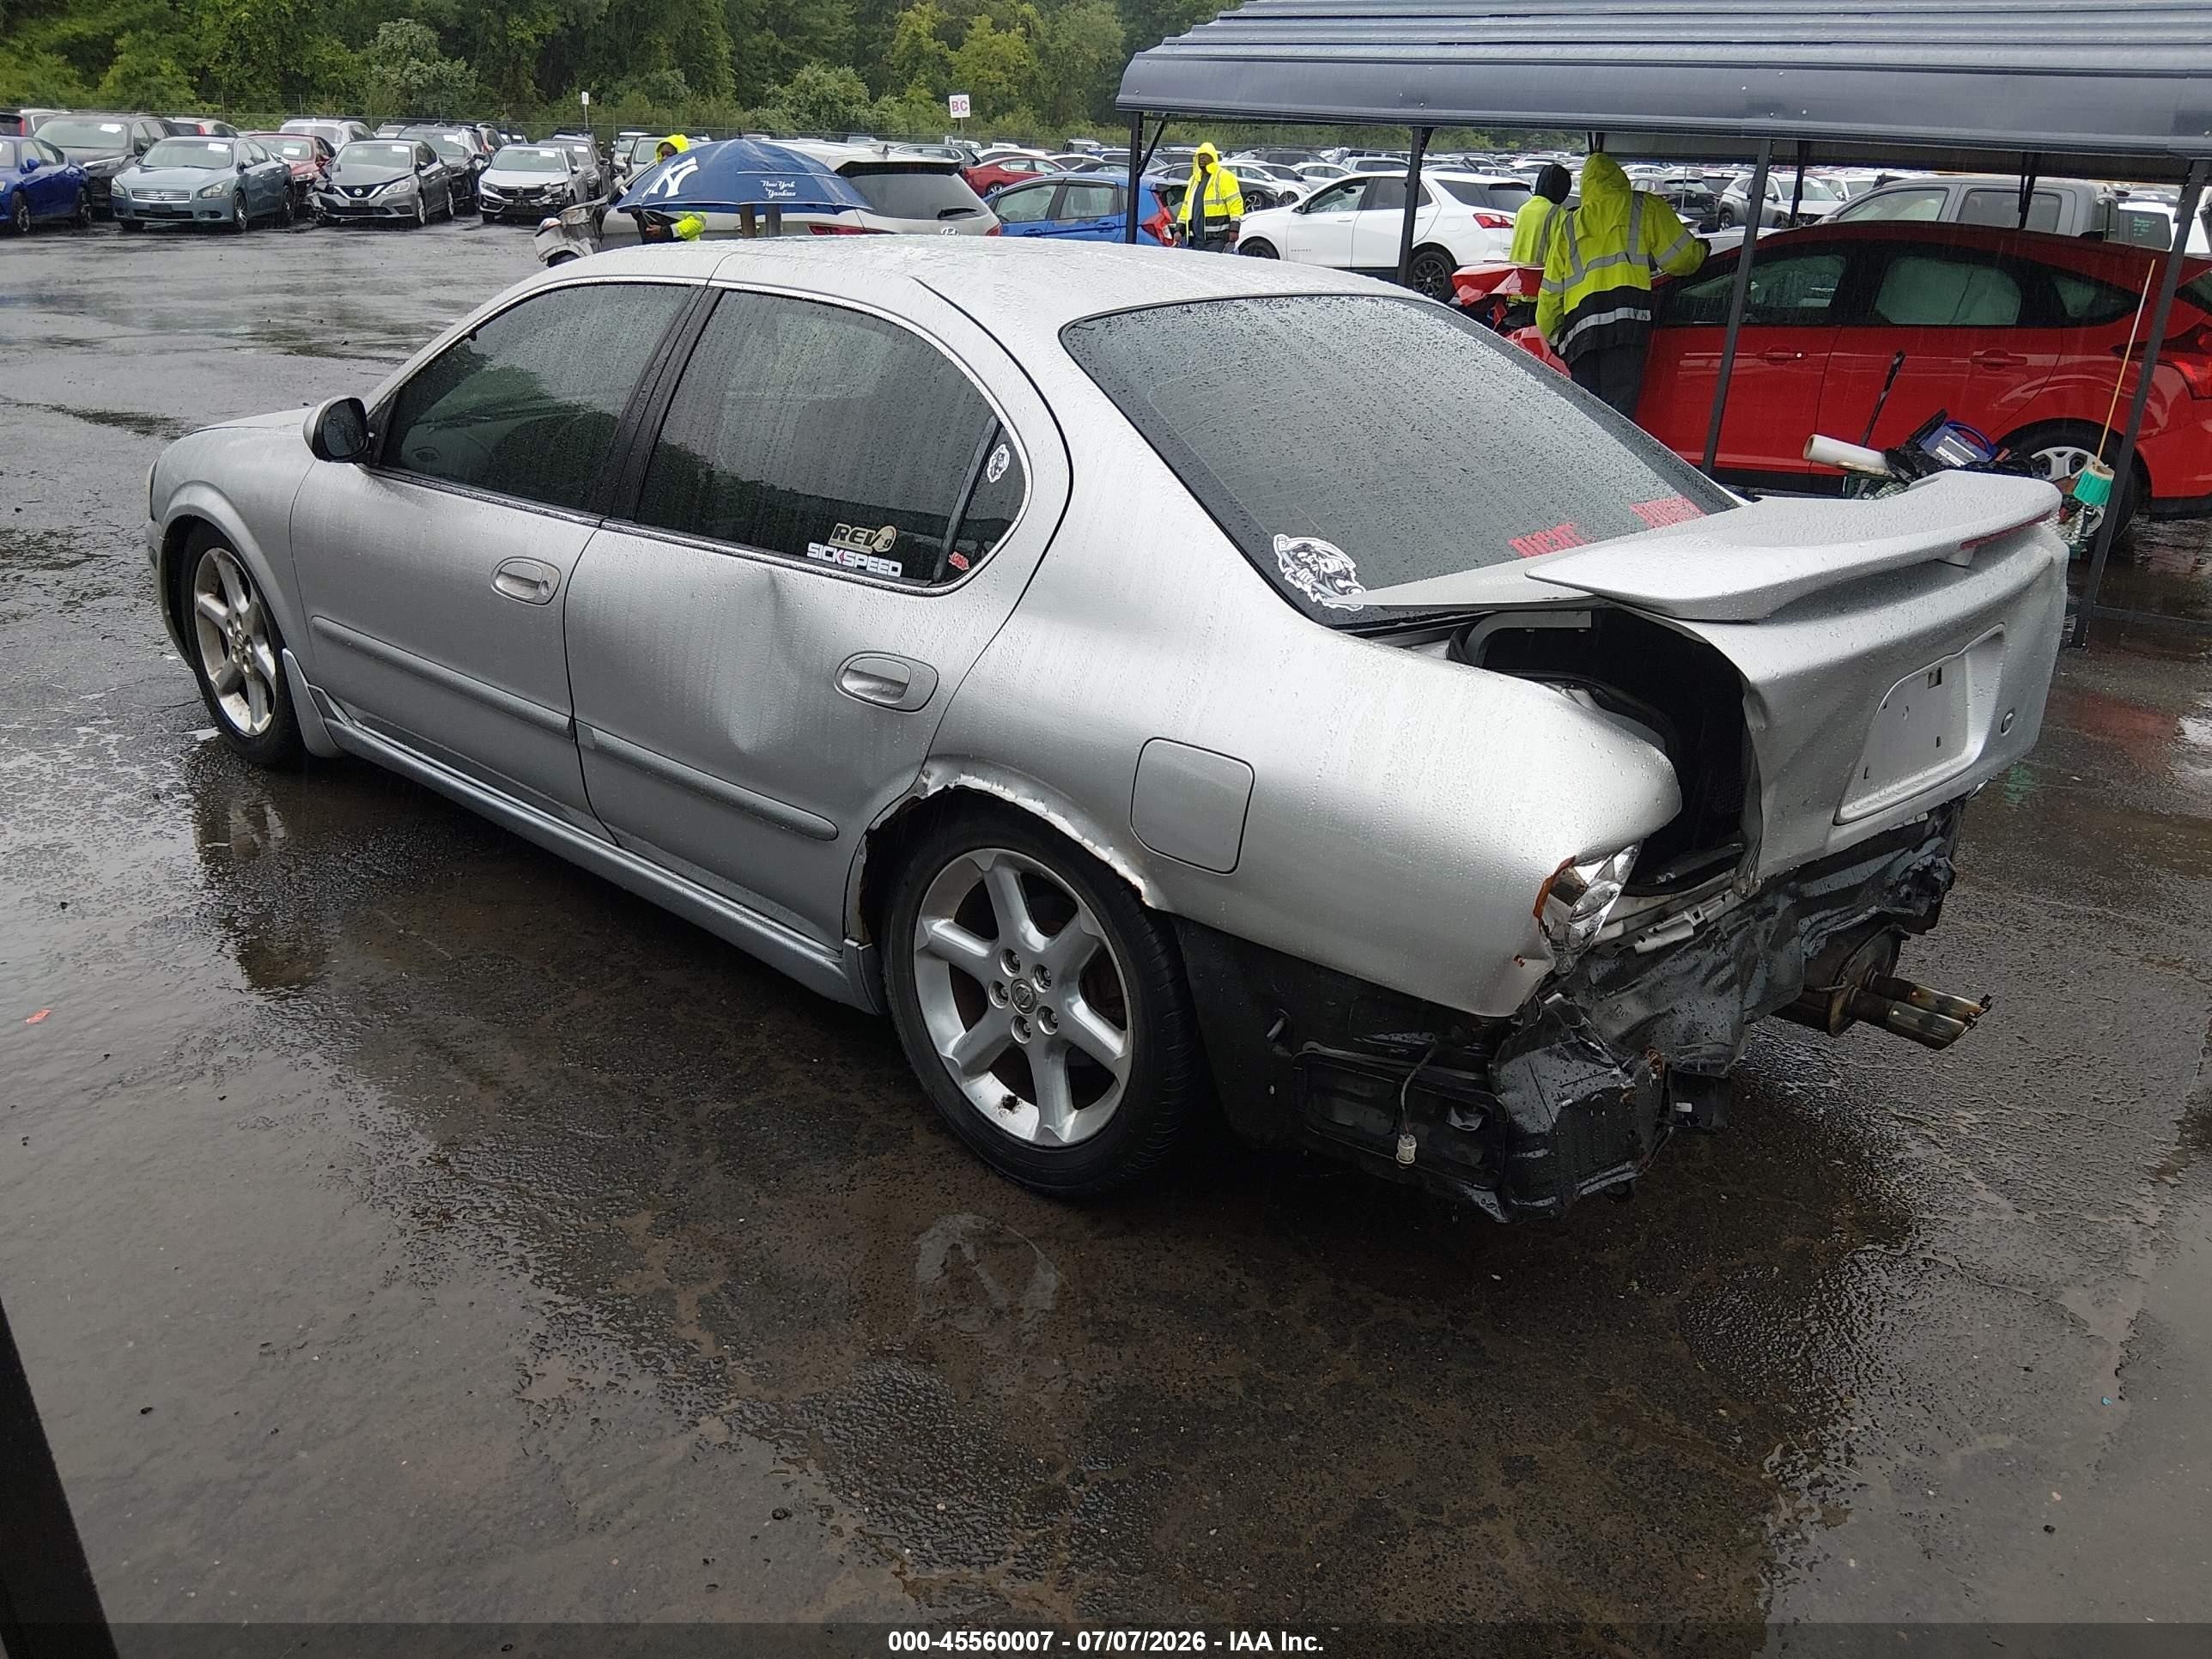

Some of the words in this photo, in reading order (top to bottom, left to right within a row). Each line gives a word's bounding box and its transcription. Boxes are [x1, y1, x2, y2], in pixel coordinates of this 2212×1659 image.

[951, 100, 969, 112] BC
[759, 179, 778, 188] New
[776, 180, 797, 191] York
[764, 186, 798, 199] Yankees
[806, 542, 902, 577] SICKSPEED
